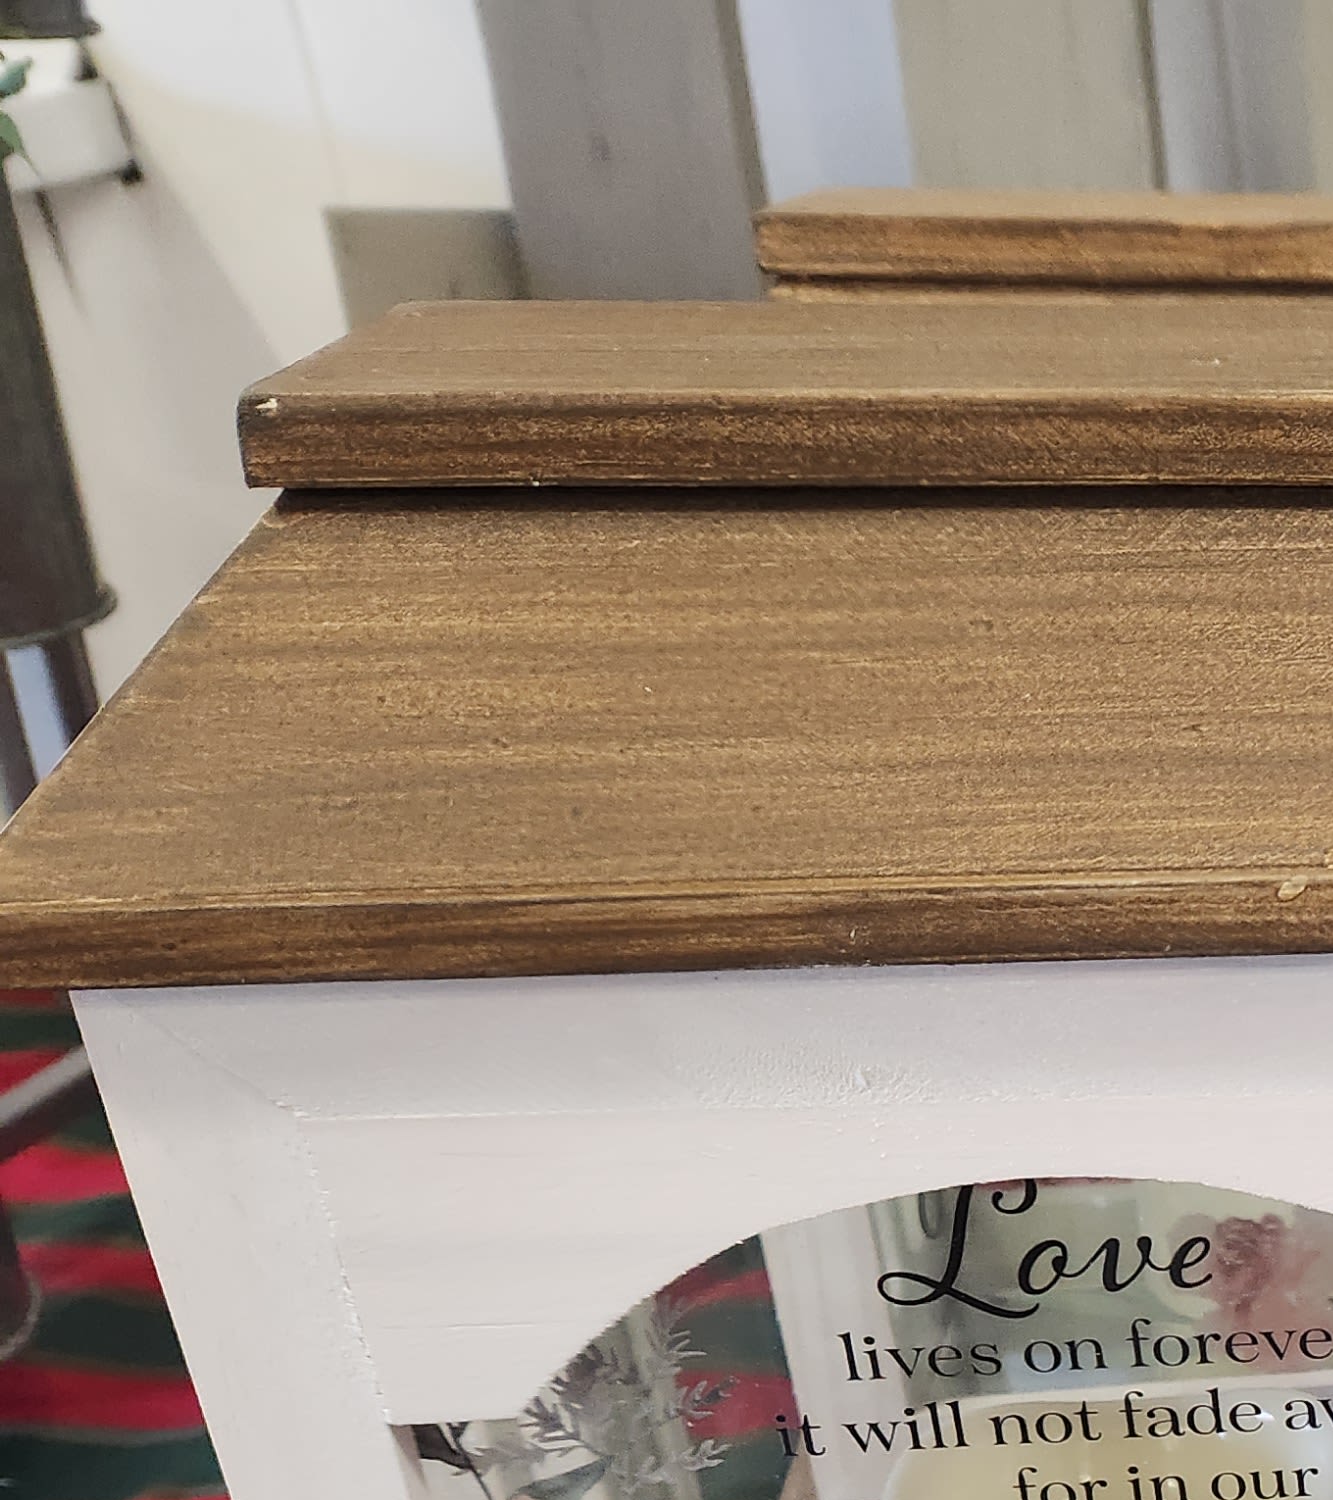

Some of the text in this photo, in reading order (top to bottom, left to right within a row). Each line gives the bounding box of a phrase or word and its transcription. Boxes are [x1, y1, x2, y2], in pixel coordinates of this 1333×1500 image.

[877, 1178, 1213, 1319] Love
[838, 1332, 1002, 1382] lives
[1023, 1337, 1109, 1375] on
[775, 1413, 826, 1458] it
[842, 1401, 971, 1454] will
[987, 1400, 1103, 1445] not
[1119, 1387, 1265, 1439] fade
